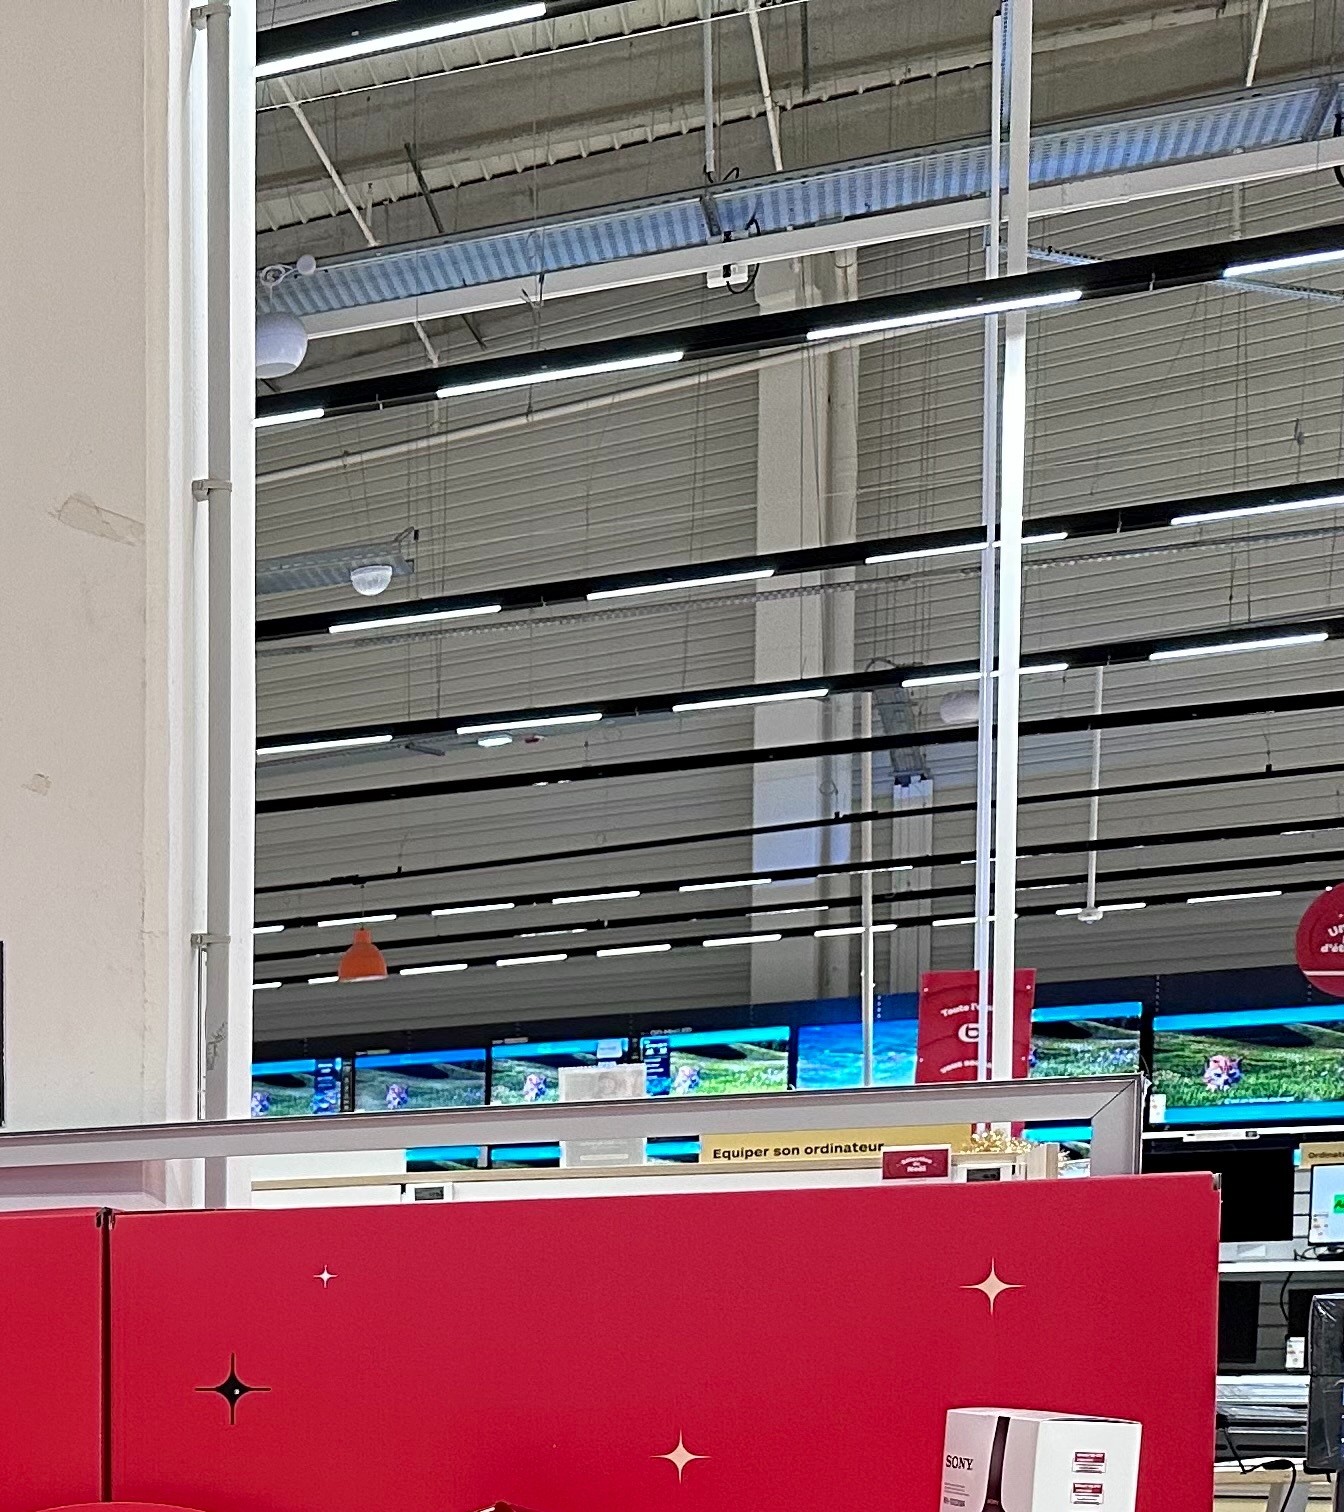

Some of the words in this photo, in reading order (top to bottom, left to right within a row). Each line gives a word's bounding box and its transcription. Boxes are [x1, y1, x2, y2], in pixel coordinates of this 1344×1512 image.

[713, 1146, 769, 1161] Equiper
[772, 1144, 800, 1156] son
[804, 1142, 884, 1155] ordinateur
[945, 1454, 974, 1471] SONY
